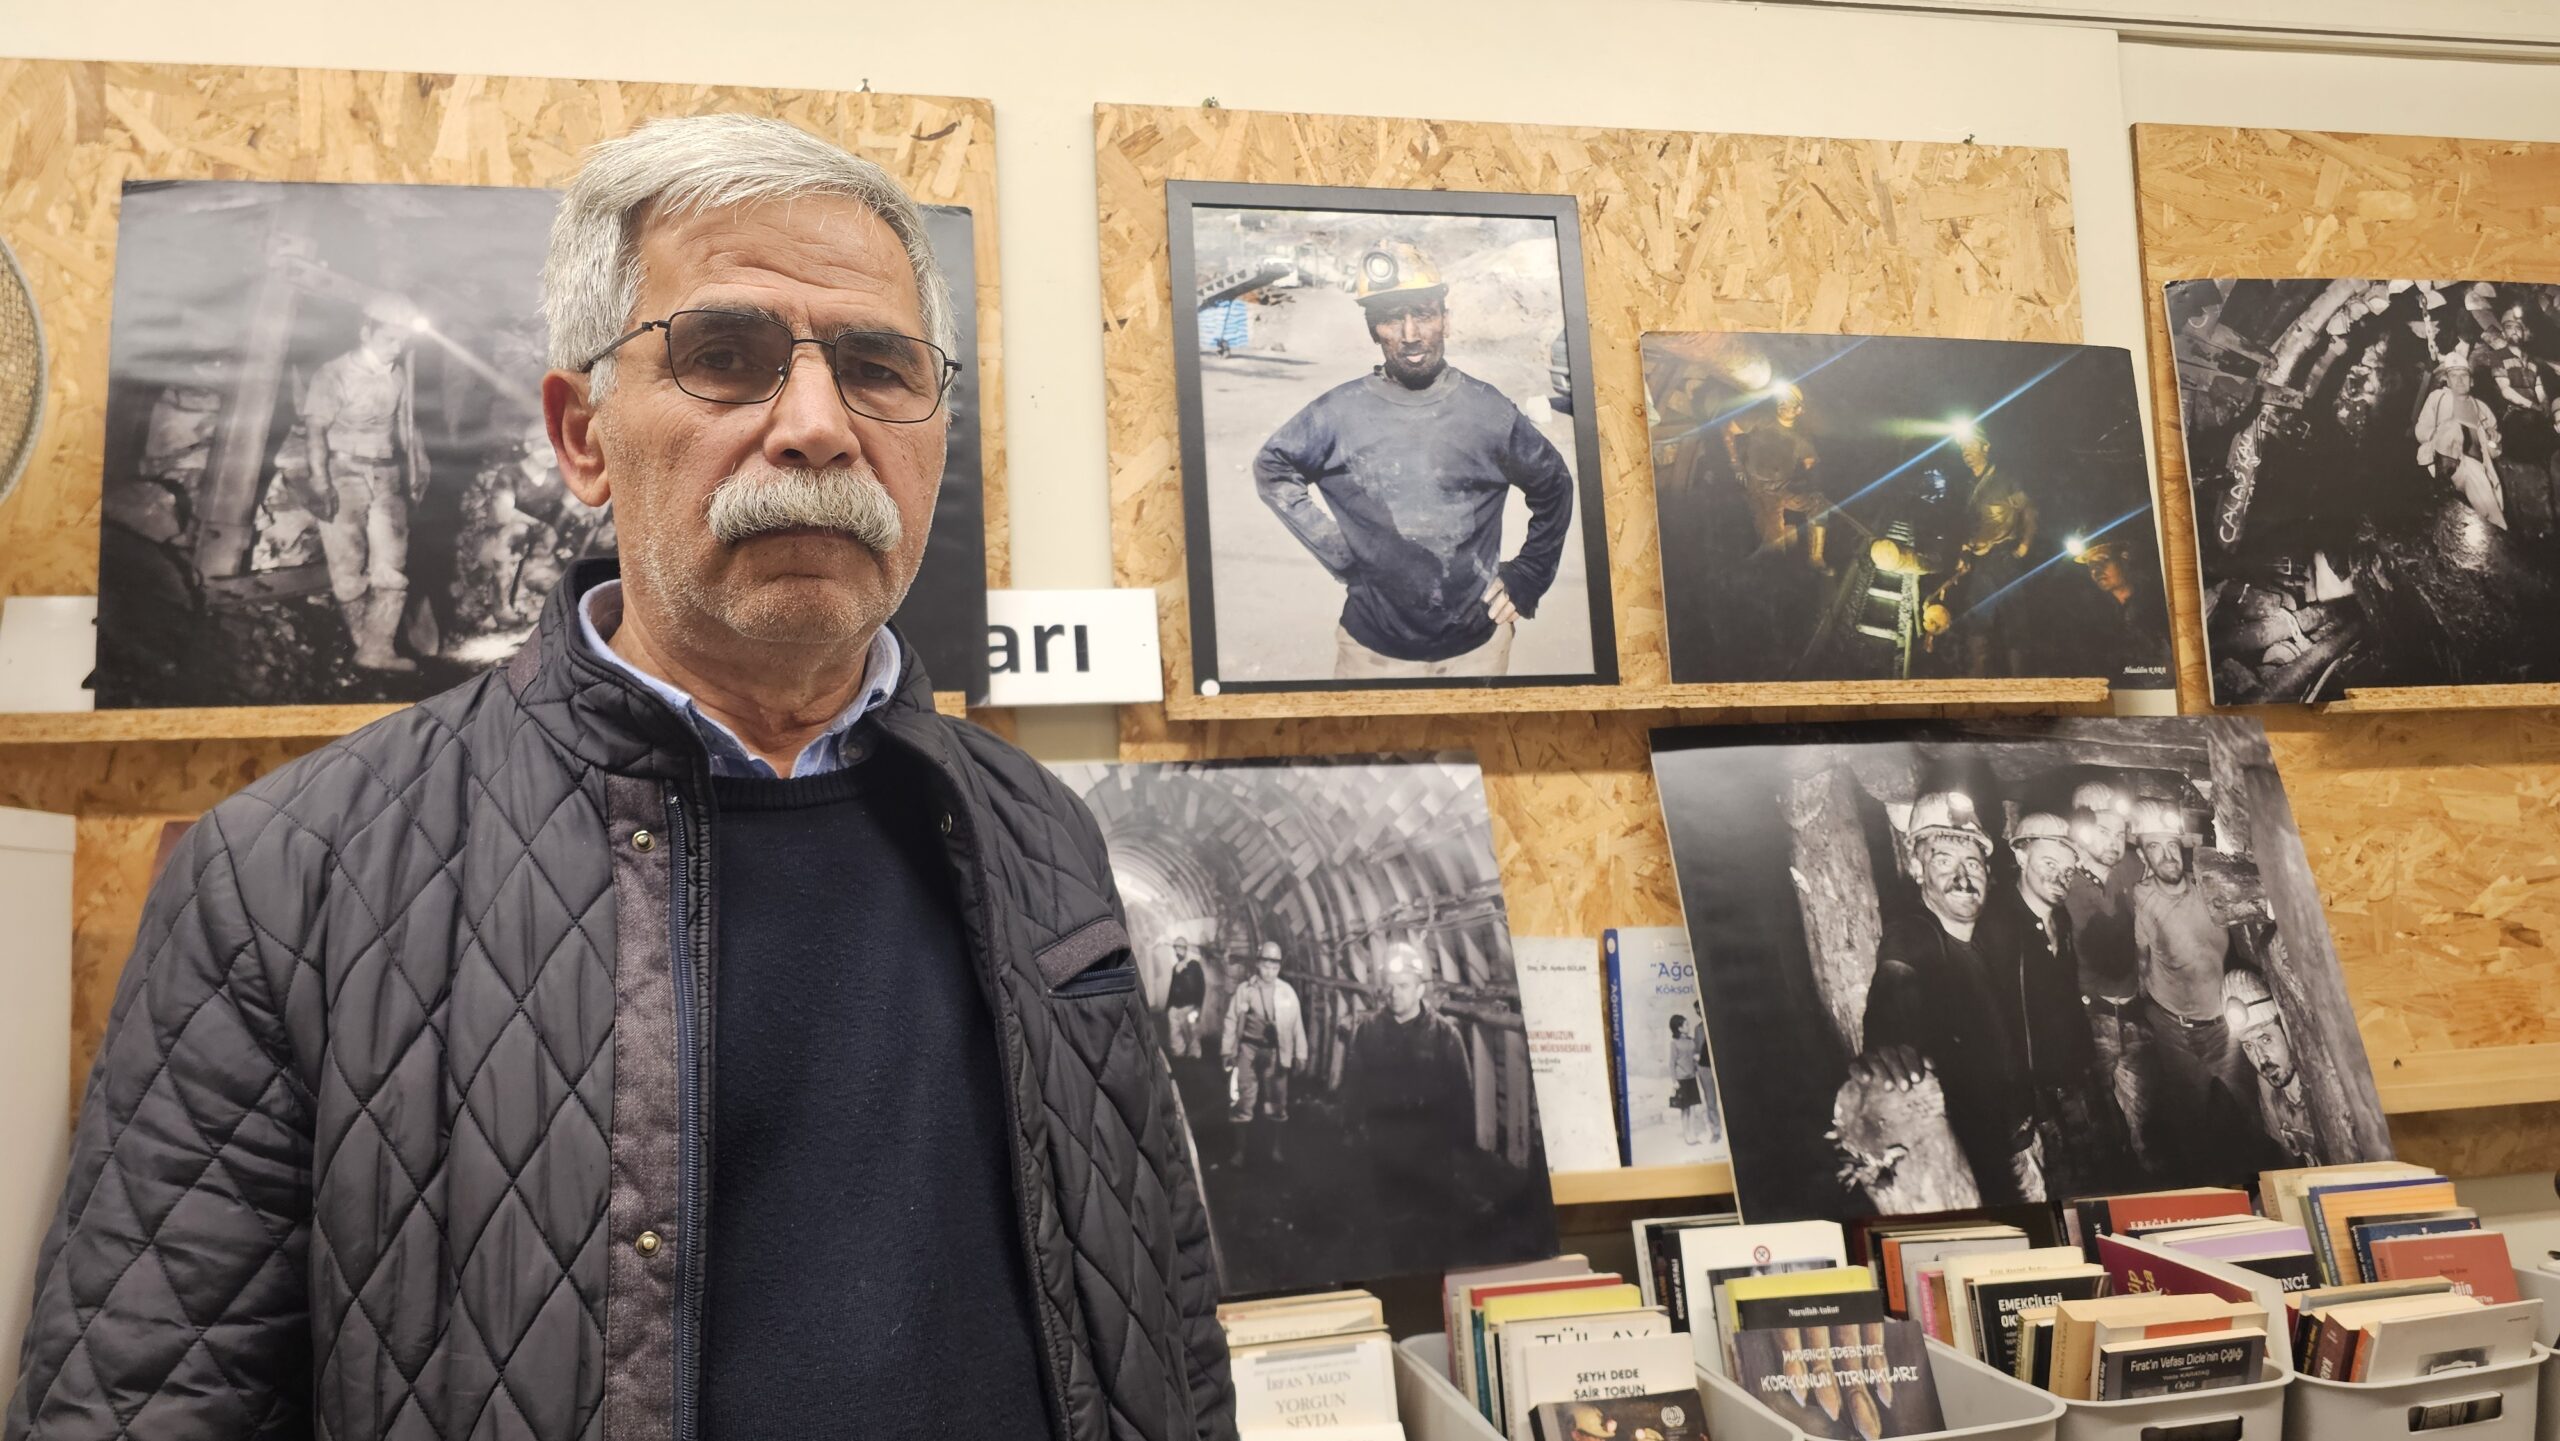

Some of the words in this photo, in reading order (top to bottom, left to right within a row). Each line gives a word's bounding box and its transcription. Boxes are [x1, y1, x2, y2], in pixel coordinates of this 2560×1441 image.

[988, 624, 1090, 674] arı
[1576, 1371, 1607, 1384] ŞEYH
[1610, 1368, 1639, 1380] DEDE
[1760, 1372, 1832, 1392] KORKUNUN
[1835, 1366, 1919, 1388] TIRNAKLARI
[1604, 1384, 1646, 1397] TORUN
[1275, 1392, 1346, 1413] YORGUN
[1286, 1412, 1339, 1428] SEVDA
